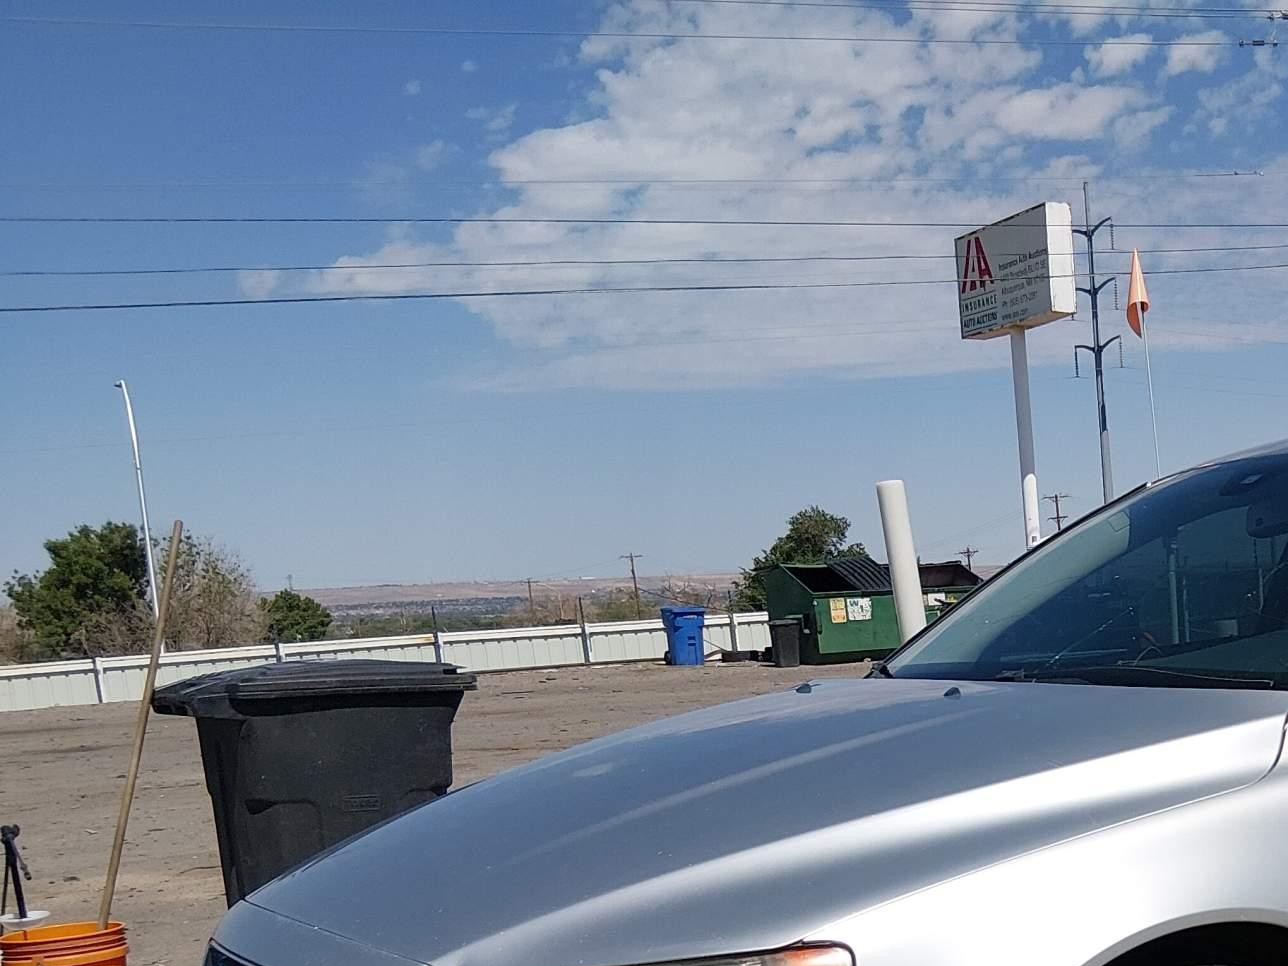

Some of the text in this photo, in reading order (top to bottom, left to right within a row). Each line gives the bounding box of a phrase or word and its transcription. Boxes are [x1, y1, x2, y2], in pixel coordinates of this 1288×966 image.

[962, 295, 997, 312] INSURANCE
[963, 317, 976, 329] AUTO
[976, 312, 998, 325] AUCTIONS
